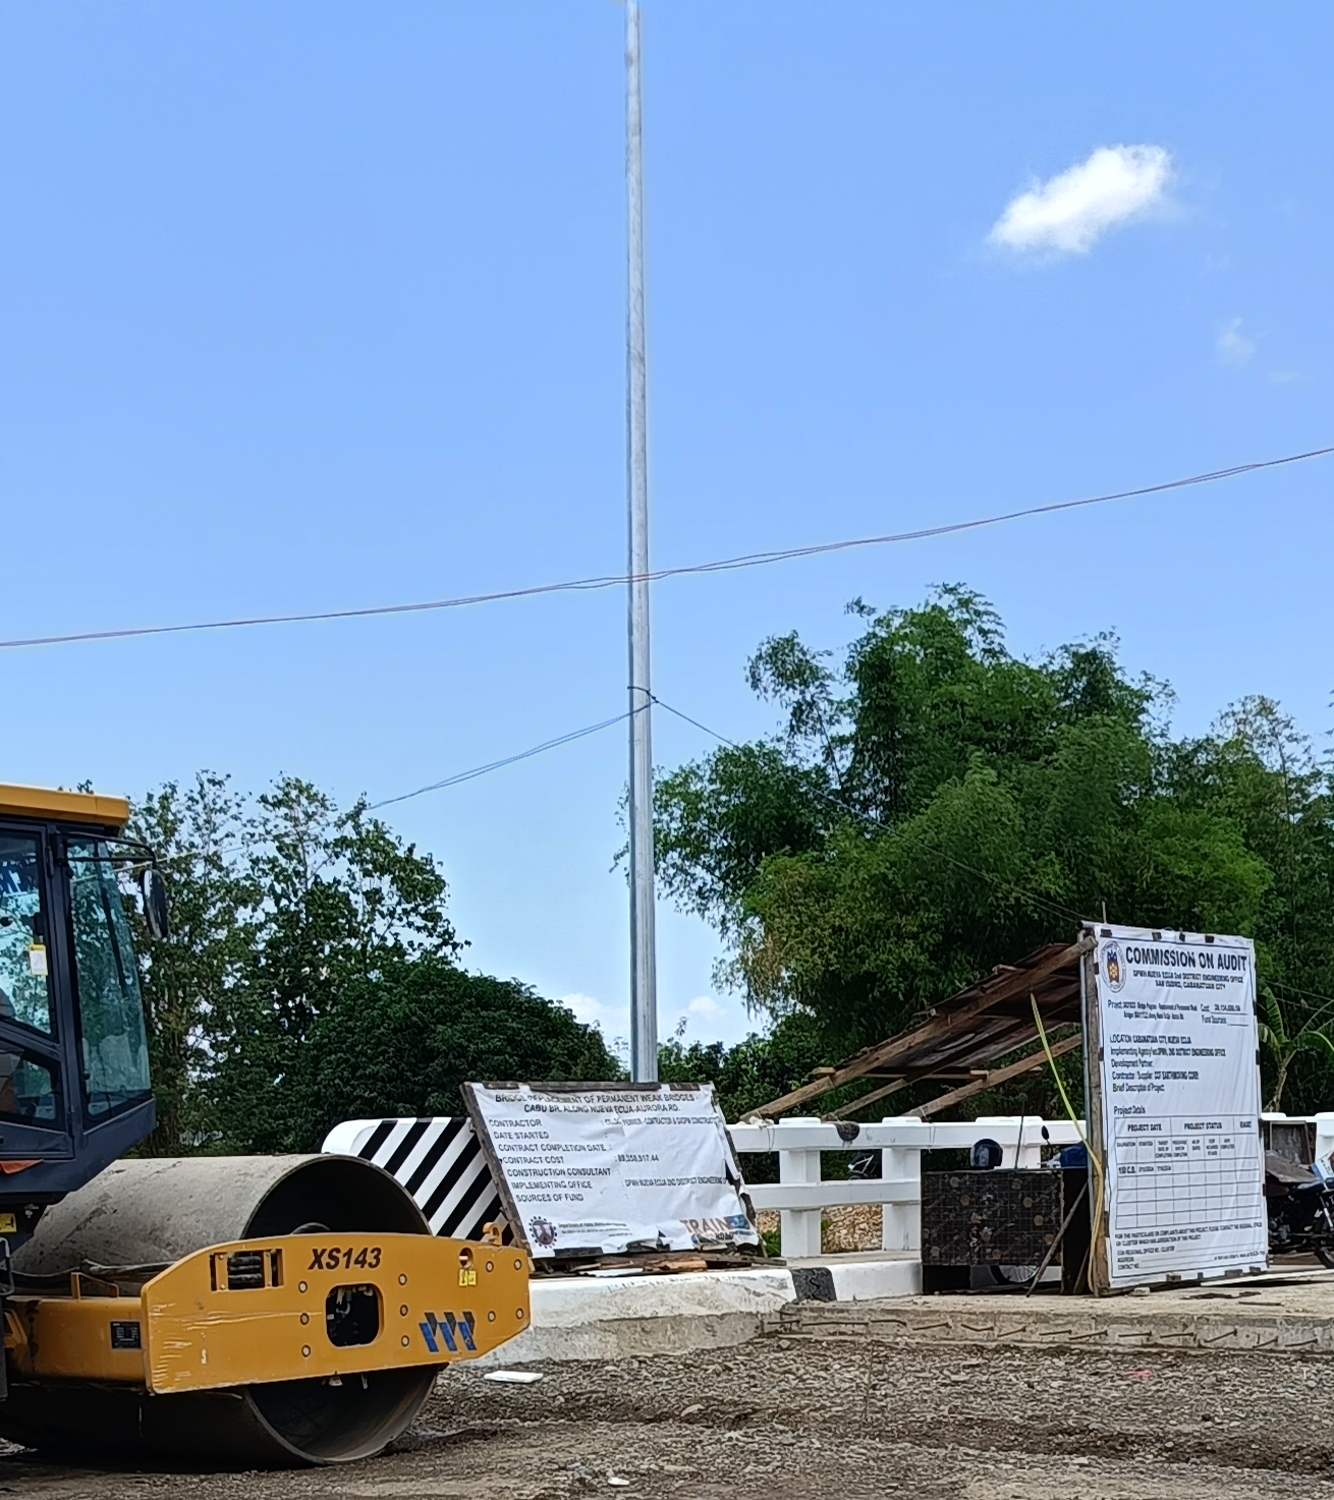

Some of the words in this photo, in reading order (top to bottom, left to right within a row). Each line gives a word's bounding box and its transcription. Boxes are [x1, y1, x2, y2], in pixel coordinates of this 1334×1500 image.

[1125, 946, 1196, 968] COMMISSION
[1199, 952, 1214, 970] ON
[1217, 953, 1247, 971] AUDIT
[584, 1095, 595, 1103] OF
[597, 1094, 639, 1103] PERMANENT
[641, 1094, 663, 1102] WEAK
[664, 1093, 695, 1102] BRIDGES
[524, 1104, 547, 1113] CABU
[563, 1104, 589, 1113] ALONG
[590, 1104, 613, 1113] NUEVA
[489, 1119, 542, 1127] CONTRACTOR
[494, 1131, 514, 1139] DATE
[514, 1131, 549, 1140] STARTED
[498, 1143, 539, 1152] CONTRACT
[540, 1143, 587, 1152] COMPLETION
[587, 1144, 607, 1152] DATE
[502, 1156, 543, 1164] CONTRACT
[544, 1155, 565, 1164] COST
[507, 1168, 566, 1177] CONSTRUCTION
[566, 1167, 611, 1176] CONSULTANT
[511, 1181, 567, 1189] IMPLEMENTING
[568, 1180, 593, 1189] OFFICE
[516, 1194, 551, 1202] SOURCES
[552, 1194, 563, 1202] OF
[564, 1193, 584, 1202] FUND
[307, 1246, 383, 1271] XS143
